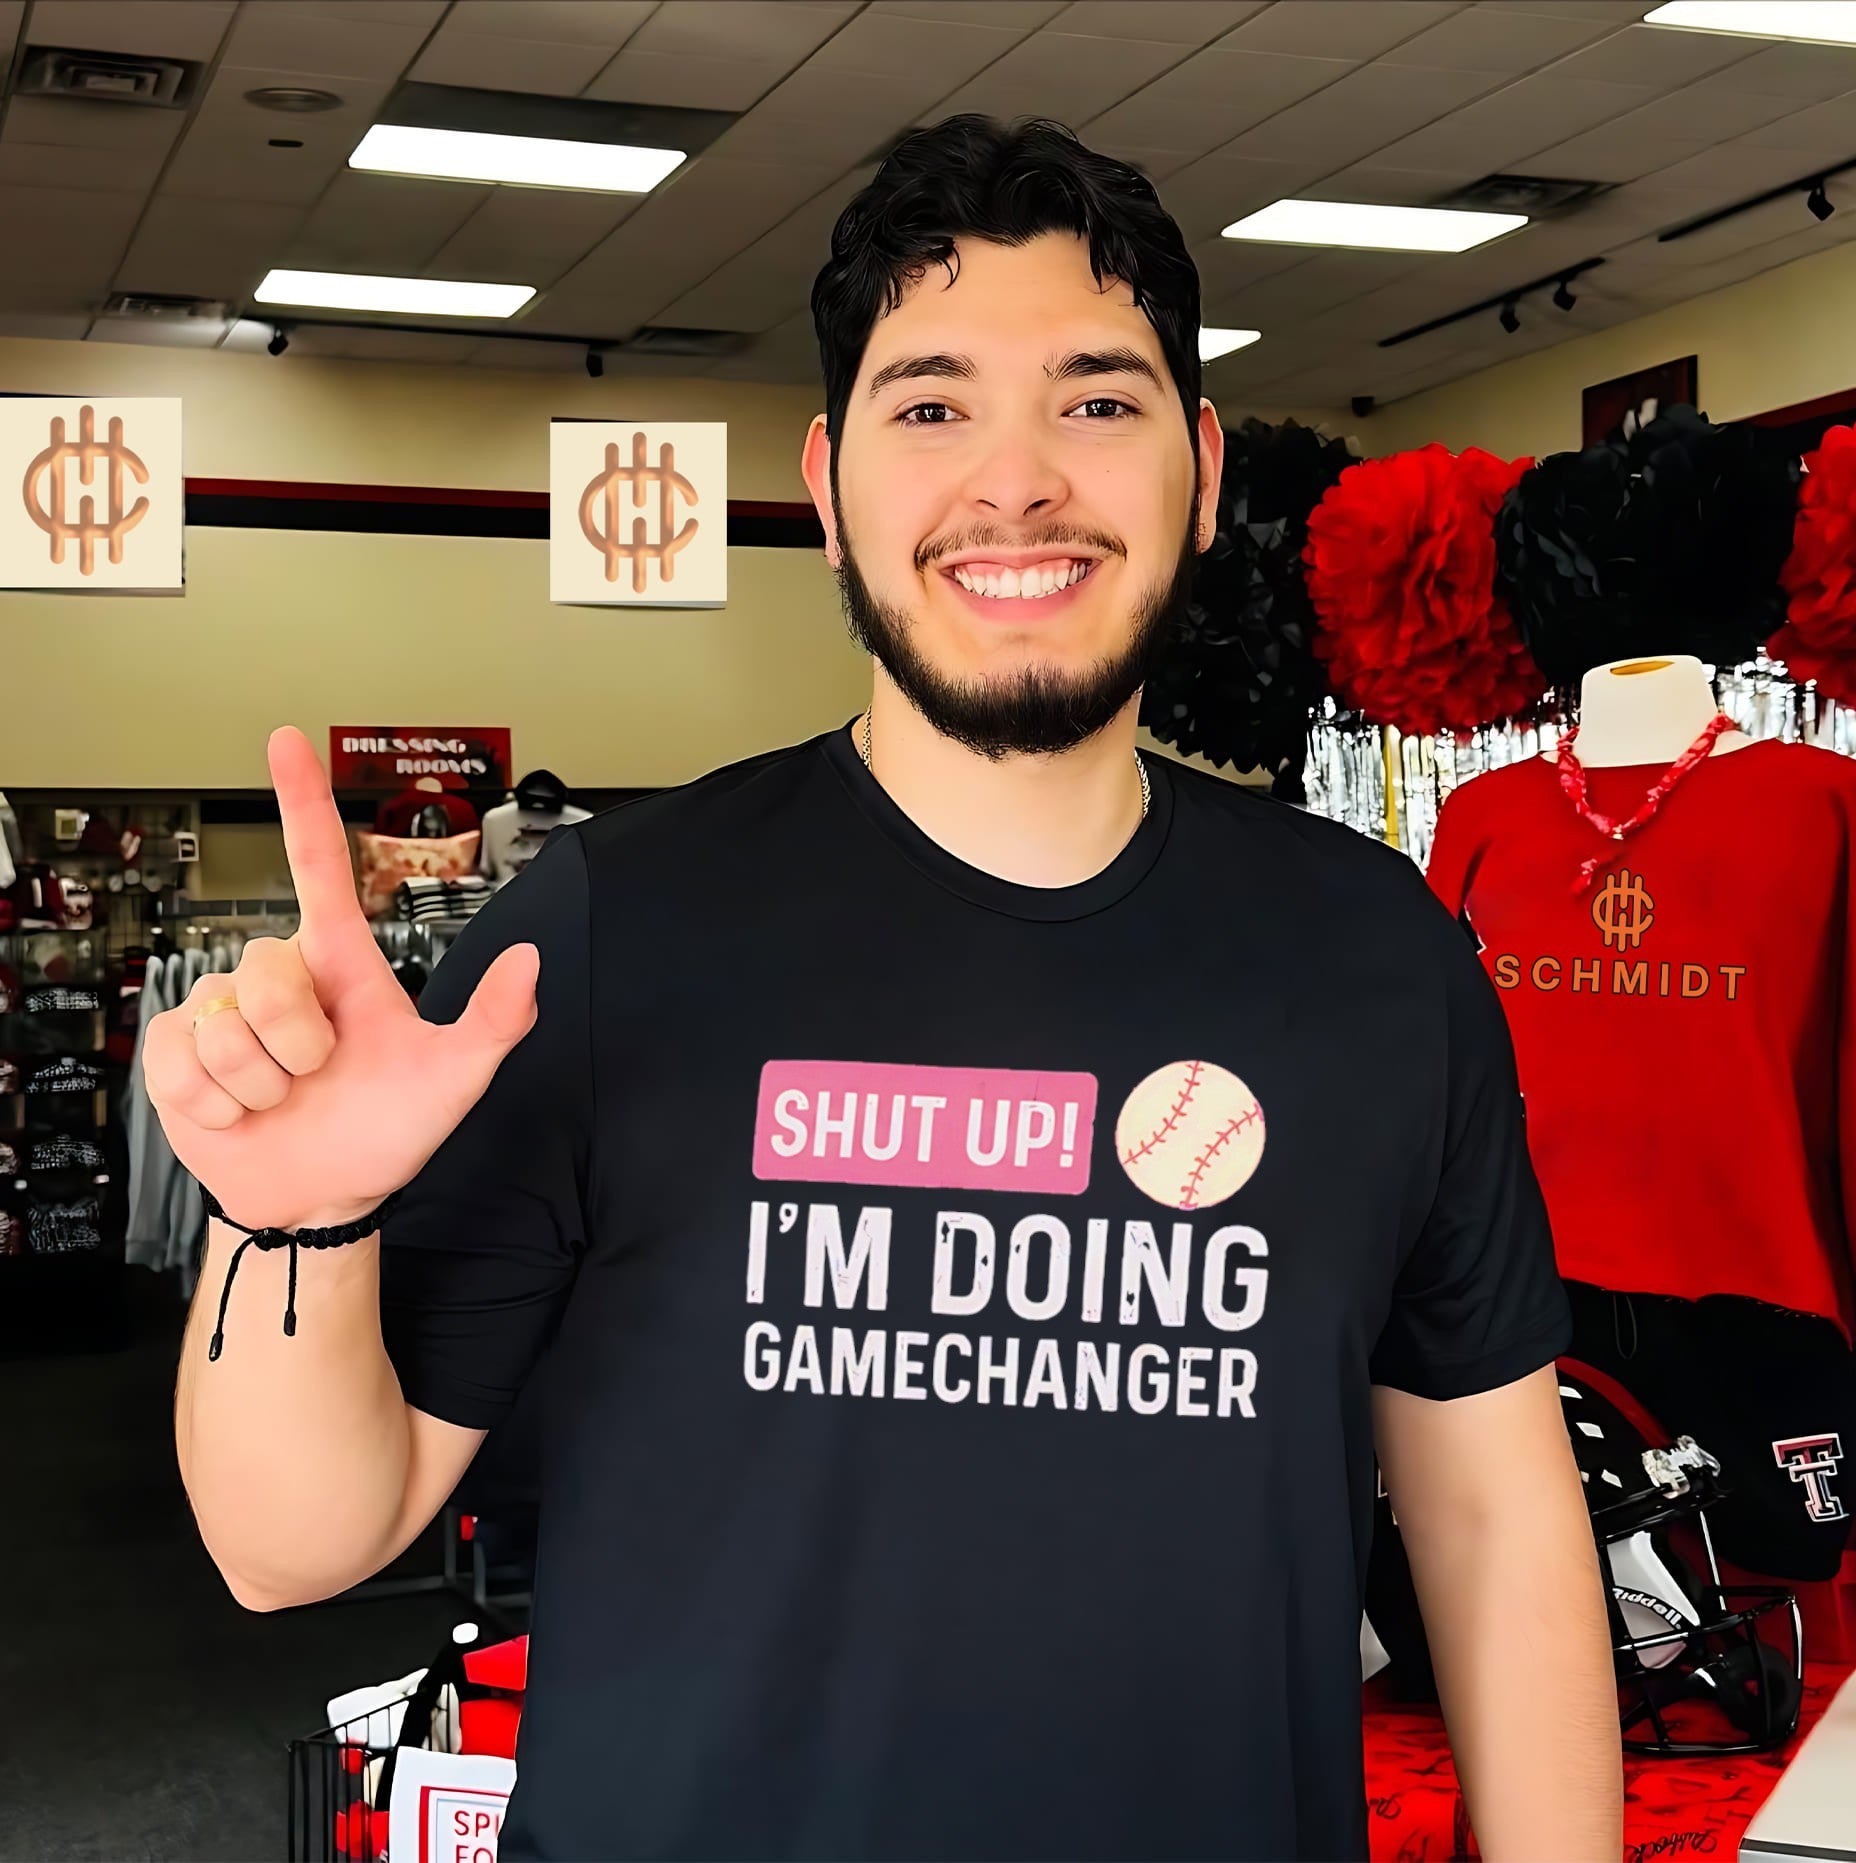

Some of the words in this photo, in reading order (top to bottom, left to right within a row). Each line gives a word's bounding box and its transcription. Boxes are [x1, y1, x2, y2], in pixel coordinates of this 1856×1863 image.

[396, 758, 487, 774] ROOMS
[1494, 953, 1747, 1000] SCHMIDT
[771, 1089, 947, 1162] SHUT
[965, 1098, 1080, 1168] UP!
[746, 1201, 892, 1311] I'M
[931, 1211, 1270, 1332] DOING
[743, 1321, 1259, 1418] GAMECHANGER
